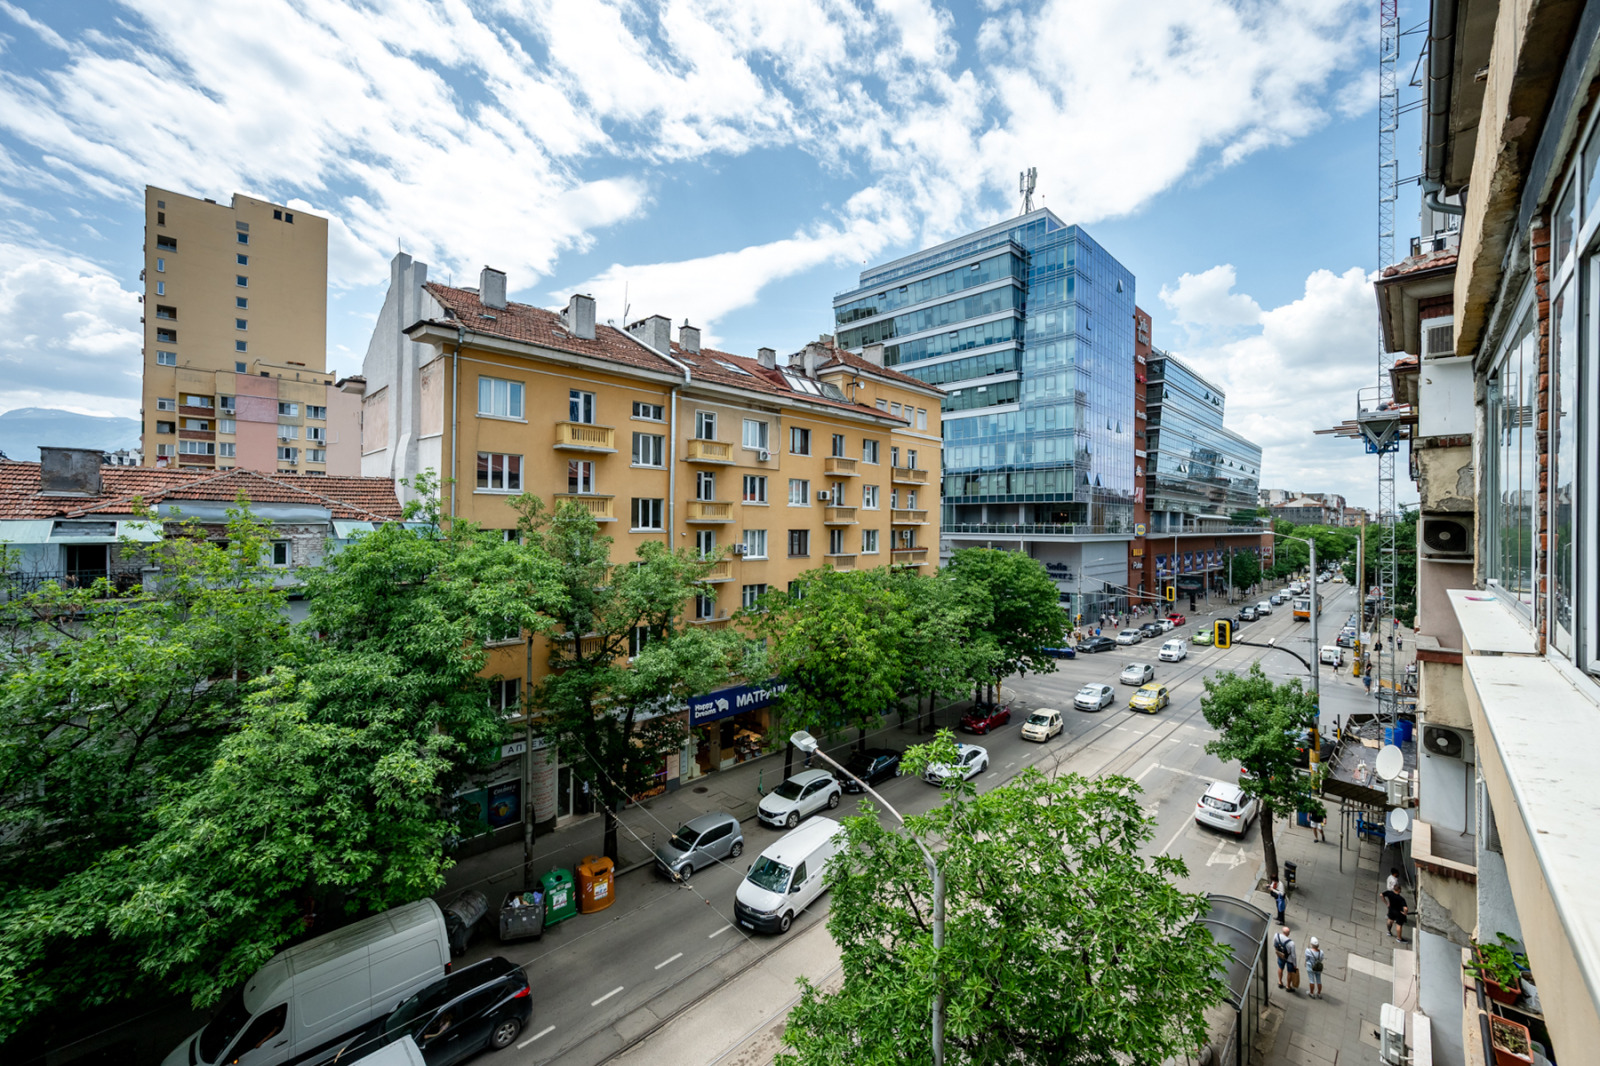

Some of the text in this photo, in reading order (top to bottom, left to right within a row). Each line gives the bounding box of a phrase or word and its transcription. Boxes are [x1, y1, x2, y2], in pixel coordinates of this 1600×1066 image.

[1046, 562, 1067, 571] Sofia
[695, 702, 714, 712] Happy
[695, 708, 717, 719] Dreams
